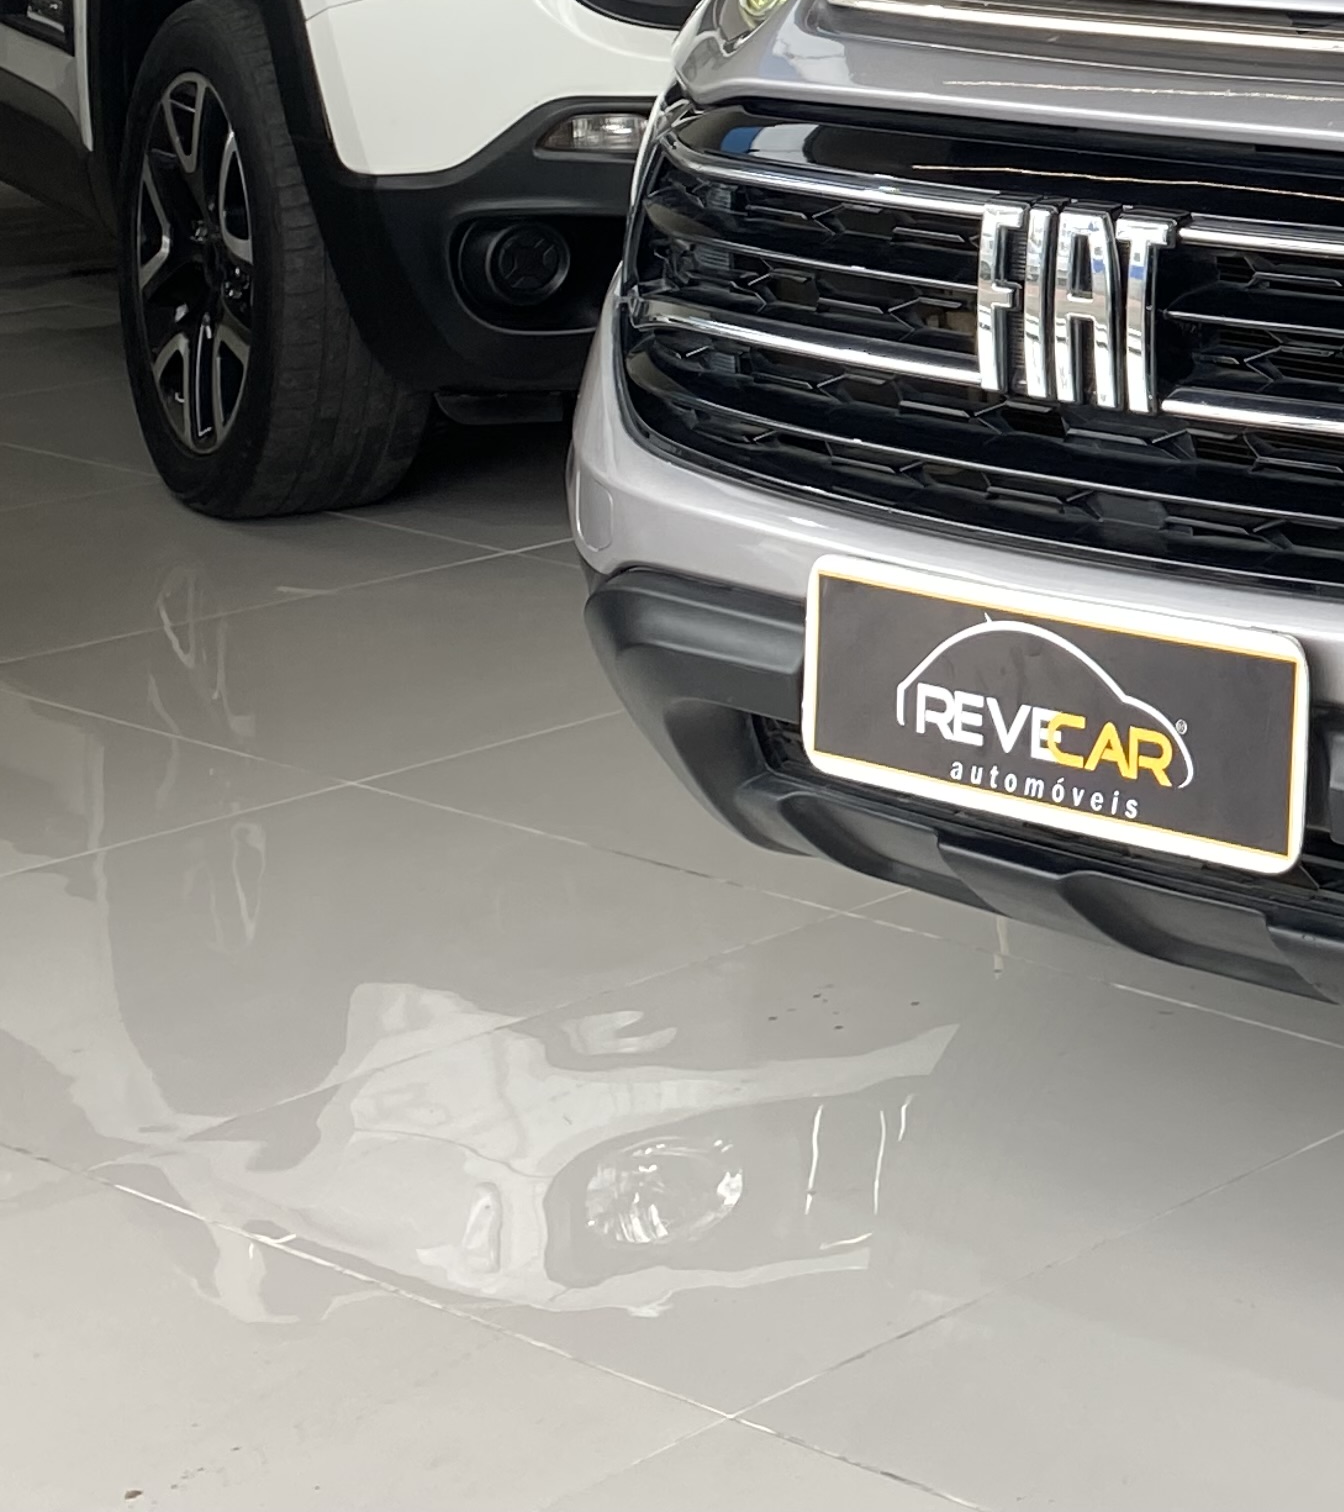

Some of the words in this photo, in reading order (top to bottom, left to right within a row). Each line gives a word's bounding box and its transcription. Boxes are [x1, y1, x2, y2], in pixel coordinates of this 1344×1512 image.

[976, 200, 1177, 414] FIAT
[915, 682, 1173, 787] REVECAR
[950, 761, 1139, 819] automóveis
